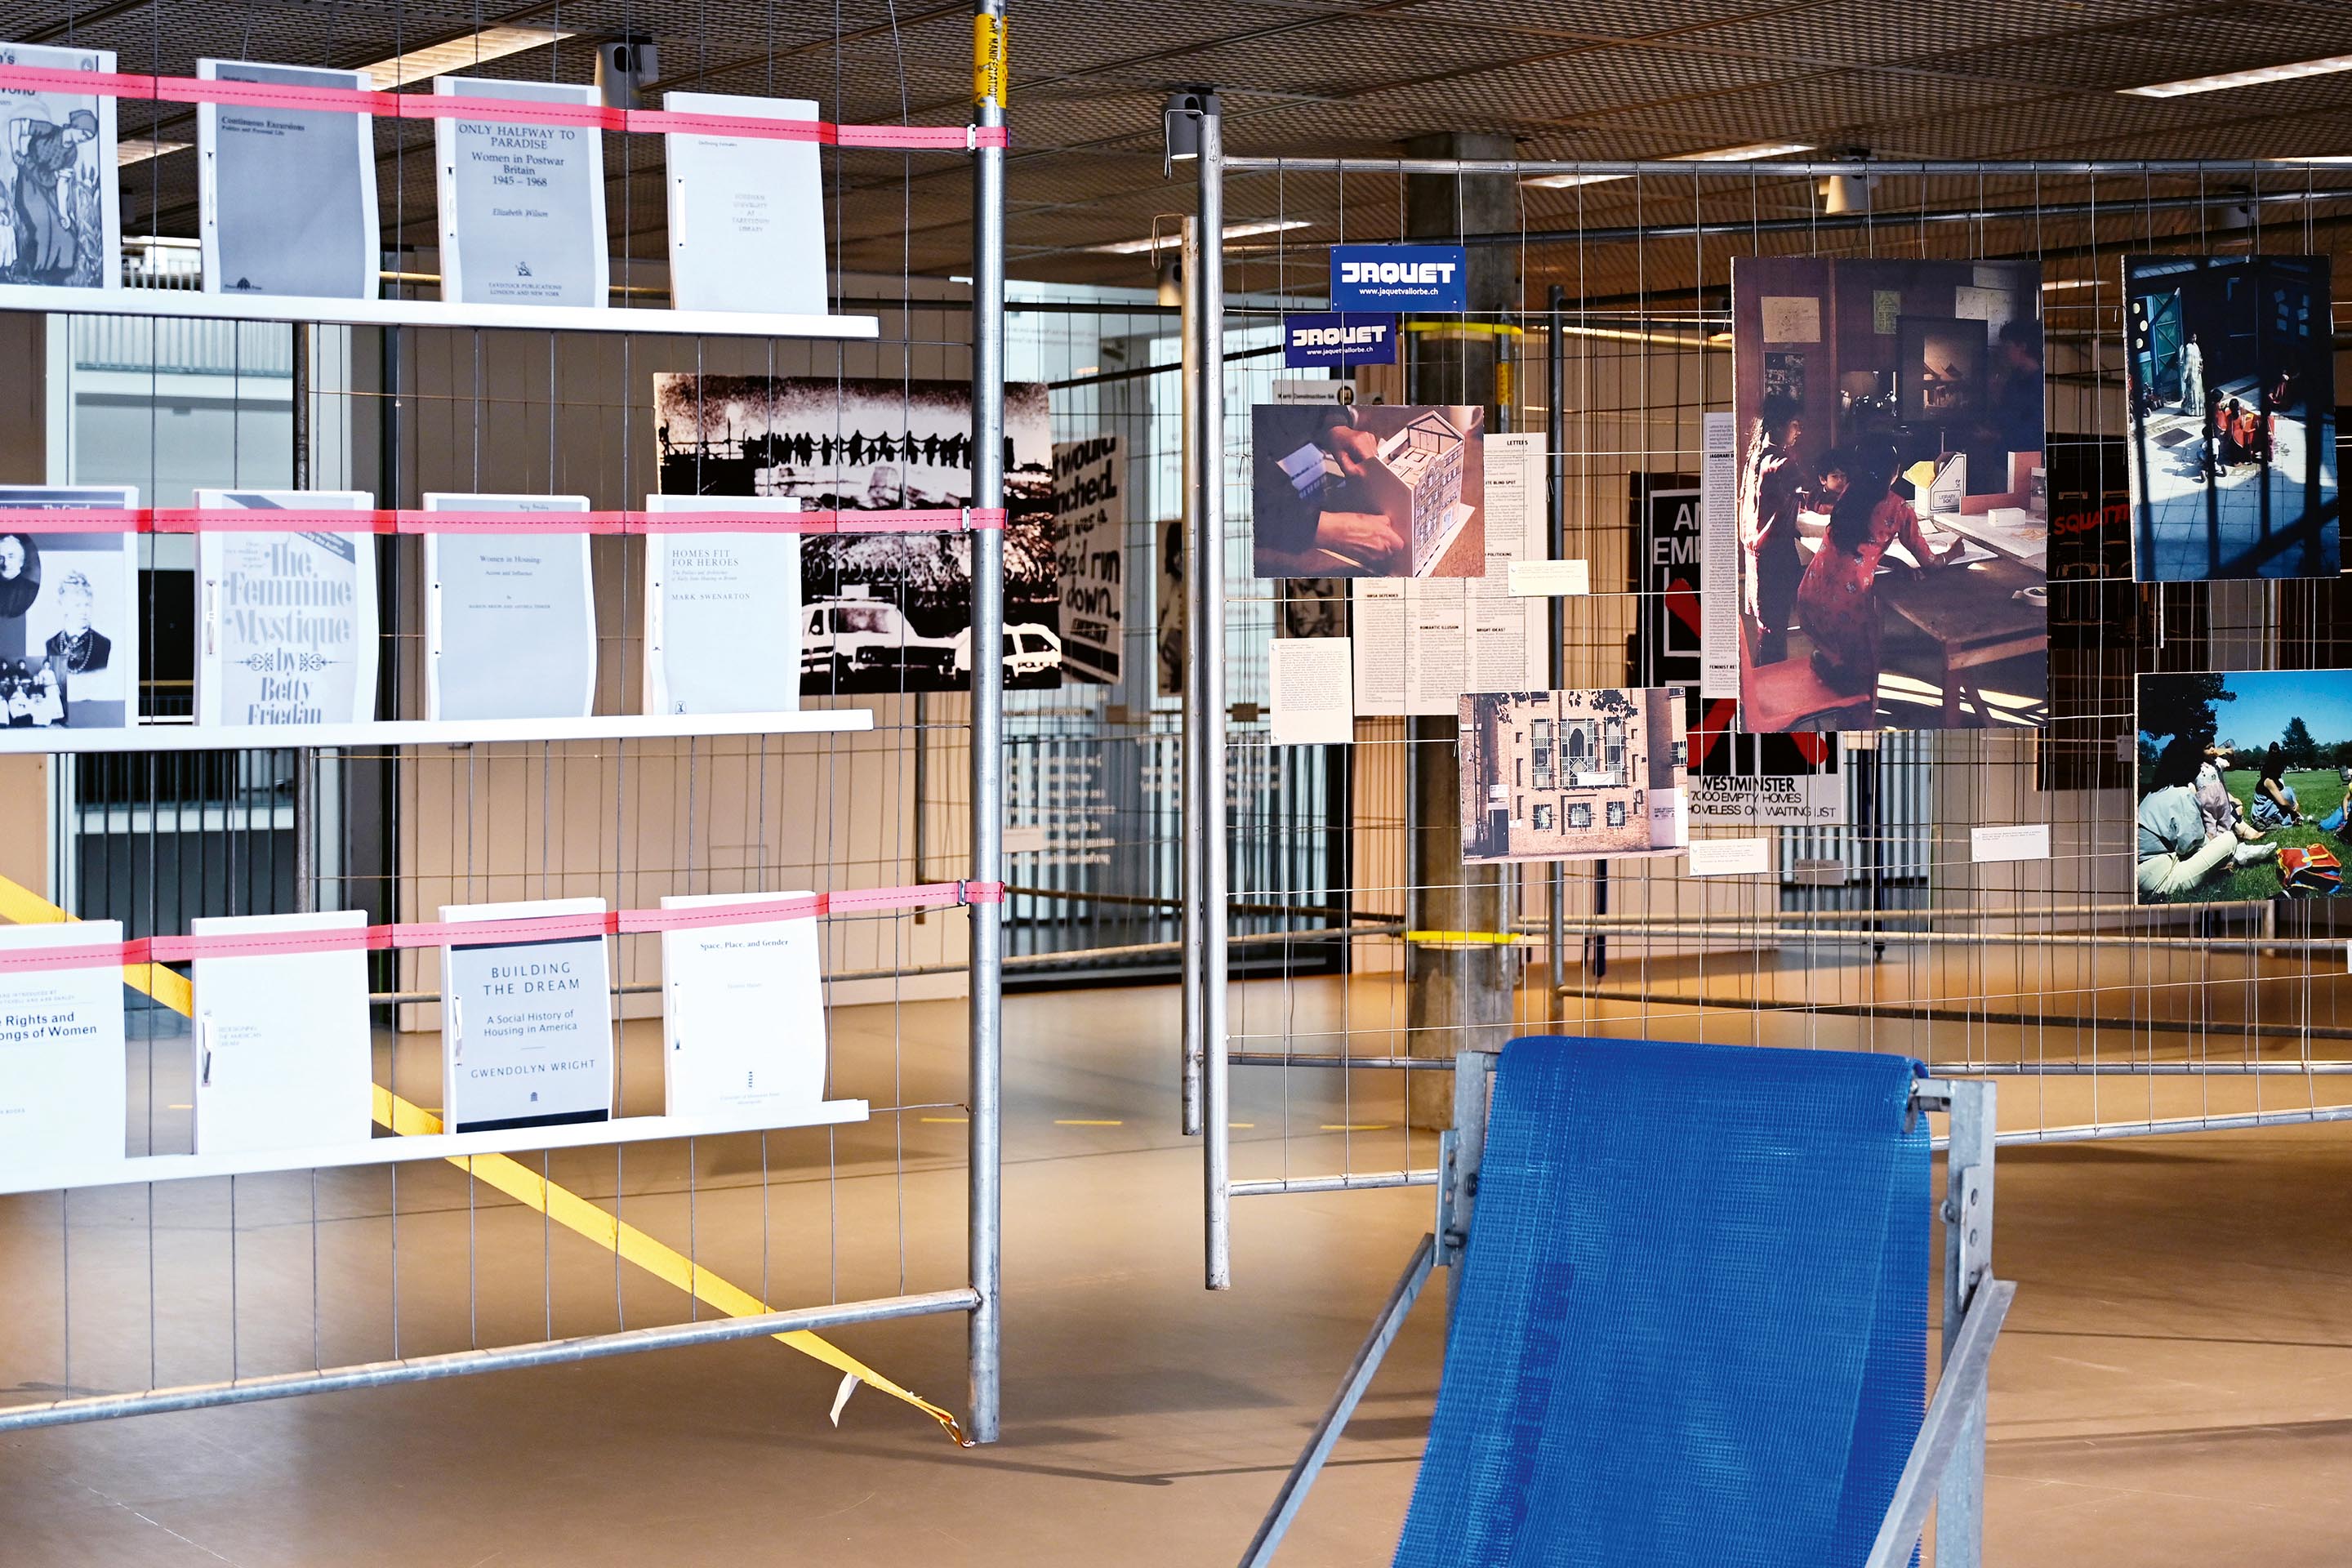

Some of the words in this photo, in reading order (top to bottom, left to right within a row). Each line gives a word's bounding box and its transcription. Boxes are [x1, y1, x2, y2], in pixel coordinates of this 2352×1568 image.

[988, 38, 999, 103] MANIFESTATION
[222, 116, 264, 127] Continuous
[266, 120, 305, 131] Excursions
[458, 124, 492, 135] ONLY
[497, 126, 555, 139] HALFWAY
[560, 130, 576, 140] TO
[491, 136, 548, 149] PARADISE
[471, 152, 510, 163] Women
[513, 154, 523, 163] in
[526, 154, 564, 167] Postwar
[503, 164, 536, 176] Britain
[493, 176, 514, 185] 1945
[527, 177, 548, 187] 1968
[492, 208, 523, 216] Elizabeth
[524, 210, 549, 218] Wilson
[1342, 262, 1456, 285] JAQUET
[1359, 287, 1439, 296] www.jaquetvallorbe.ch
[1292, 325, 1387, 346] JAQUET
[1307, 346, 1374, 356] www.jaquetallorbe.ch
[264, 541, 313, 577] The
[672, 549, 710, 558] HOMES
[713, 549, 730, 558] FIT
[672, 559, 693, 567] FOR
[697, 558, 739, 567] HEROES
[222, 570, 352, 607] Feminine
[225, 609, 350, 652] Mystique
[277, 647, 296, 676] by
[261, 676, 314, 705] Betty
[247, 702, 322, 725] Friedan
[1722, 792, 1759, 803] EMPTY
[1762, 793, 1802, 804] HOMES
[1765, 807, 1811, 817] WAITING
[746, 939, 760, 947] and
[762, 938, 789, 947] Gender
[492, 961, 571, 978] BUILDING
[483, 983, 514, 996] THE
[524, 978, 580, 993] DREAM
[6, 1013, 48, 1028] Rights
[51, 1010, 74, 1023] and
[487, 1016, 494, 1025] A
[497, 1013, 525, 1025] Social
[528, 1011, 562, 1022] History
[564, 1009, 574, 1018] of
[33, 1027, 45, 1039] of
[47, 1026, 97, 1037] Women
[484, 1027, 524, 1036] Housing
[527, 1025, 537, 1033] in
[539, 1022, 577, 1033] America
[470, 1064, 546, 1079] GWENDOLYN
[550, 1059, 595, 1071] WRIGHT
